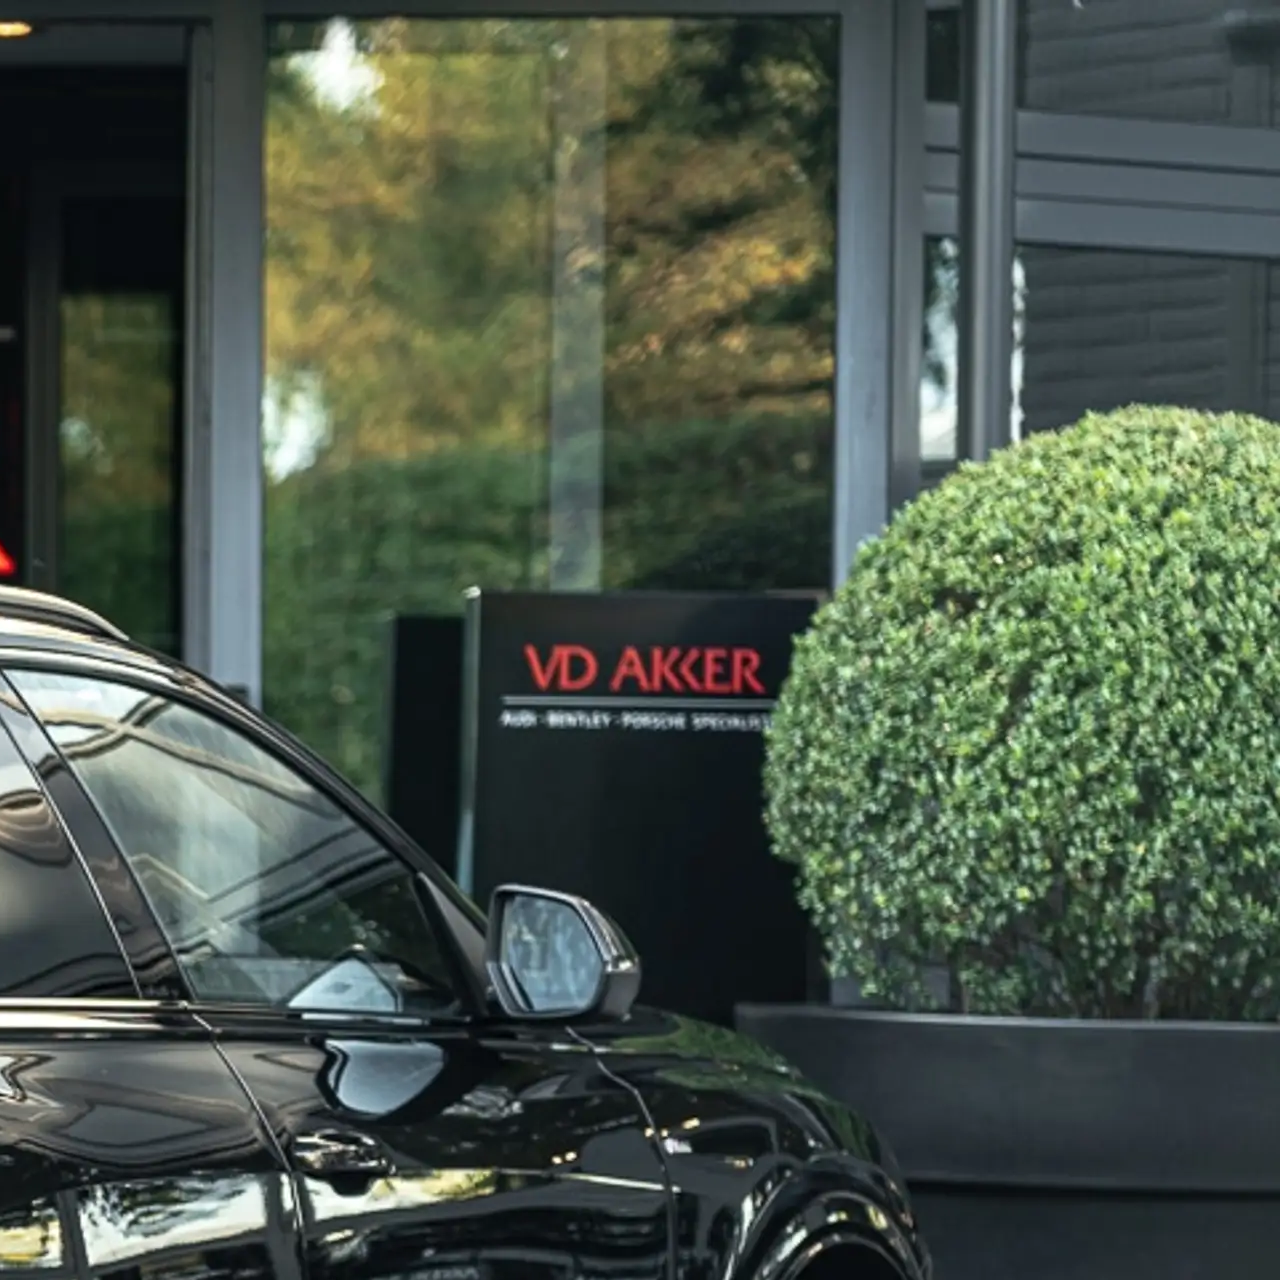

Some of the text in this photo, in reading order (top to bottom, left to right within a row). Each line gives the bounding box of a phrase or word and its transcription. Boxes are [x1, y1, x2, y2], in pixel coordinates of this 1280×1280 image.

[524, 643, 766, 694] VD AKKER
[500, 709, 538, 728] AUDI
[546, 709, 611, 730] BENTLEY
[621, 711, 686, 731] PORSCHE
